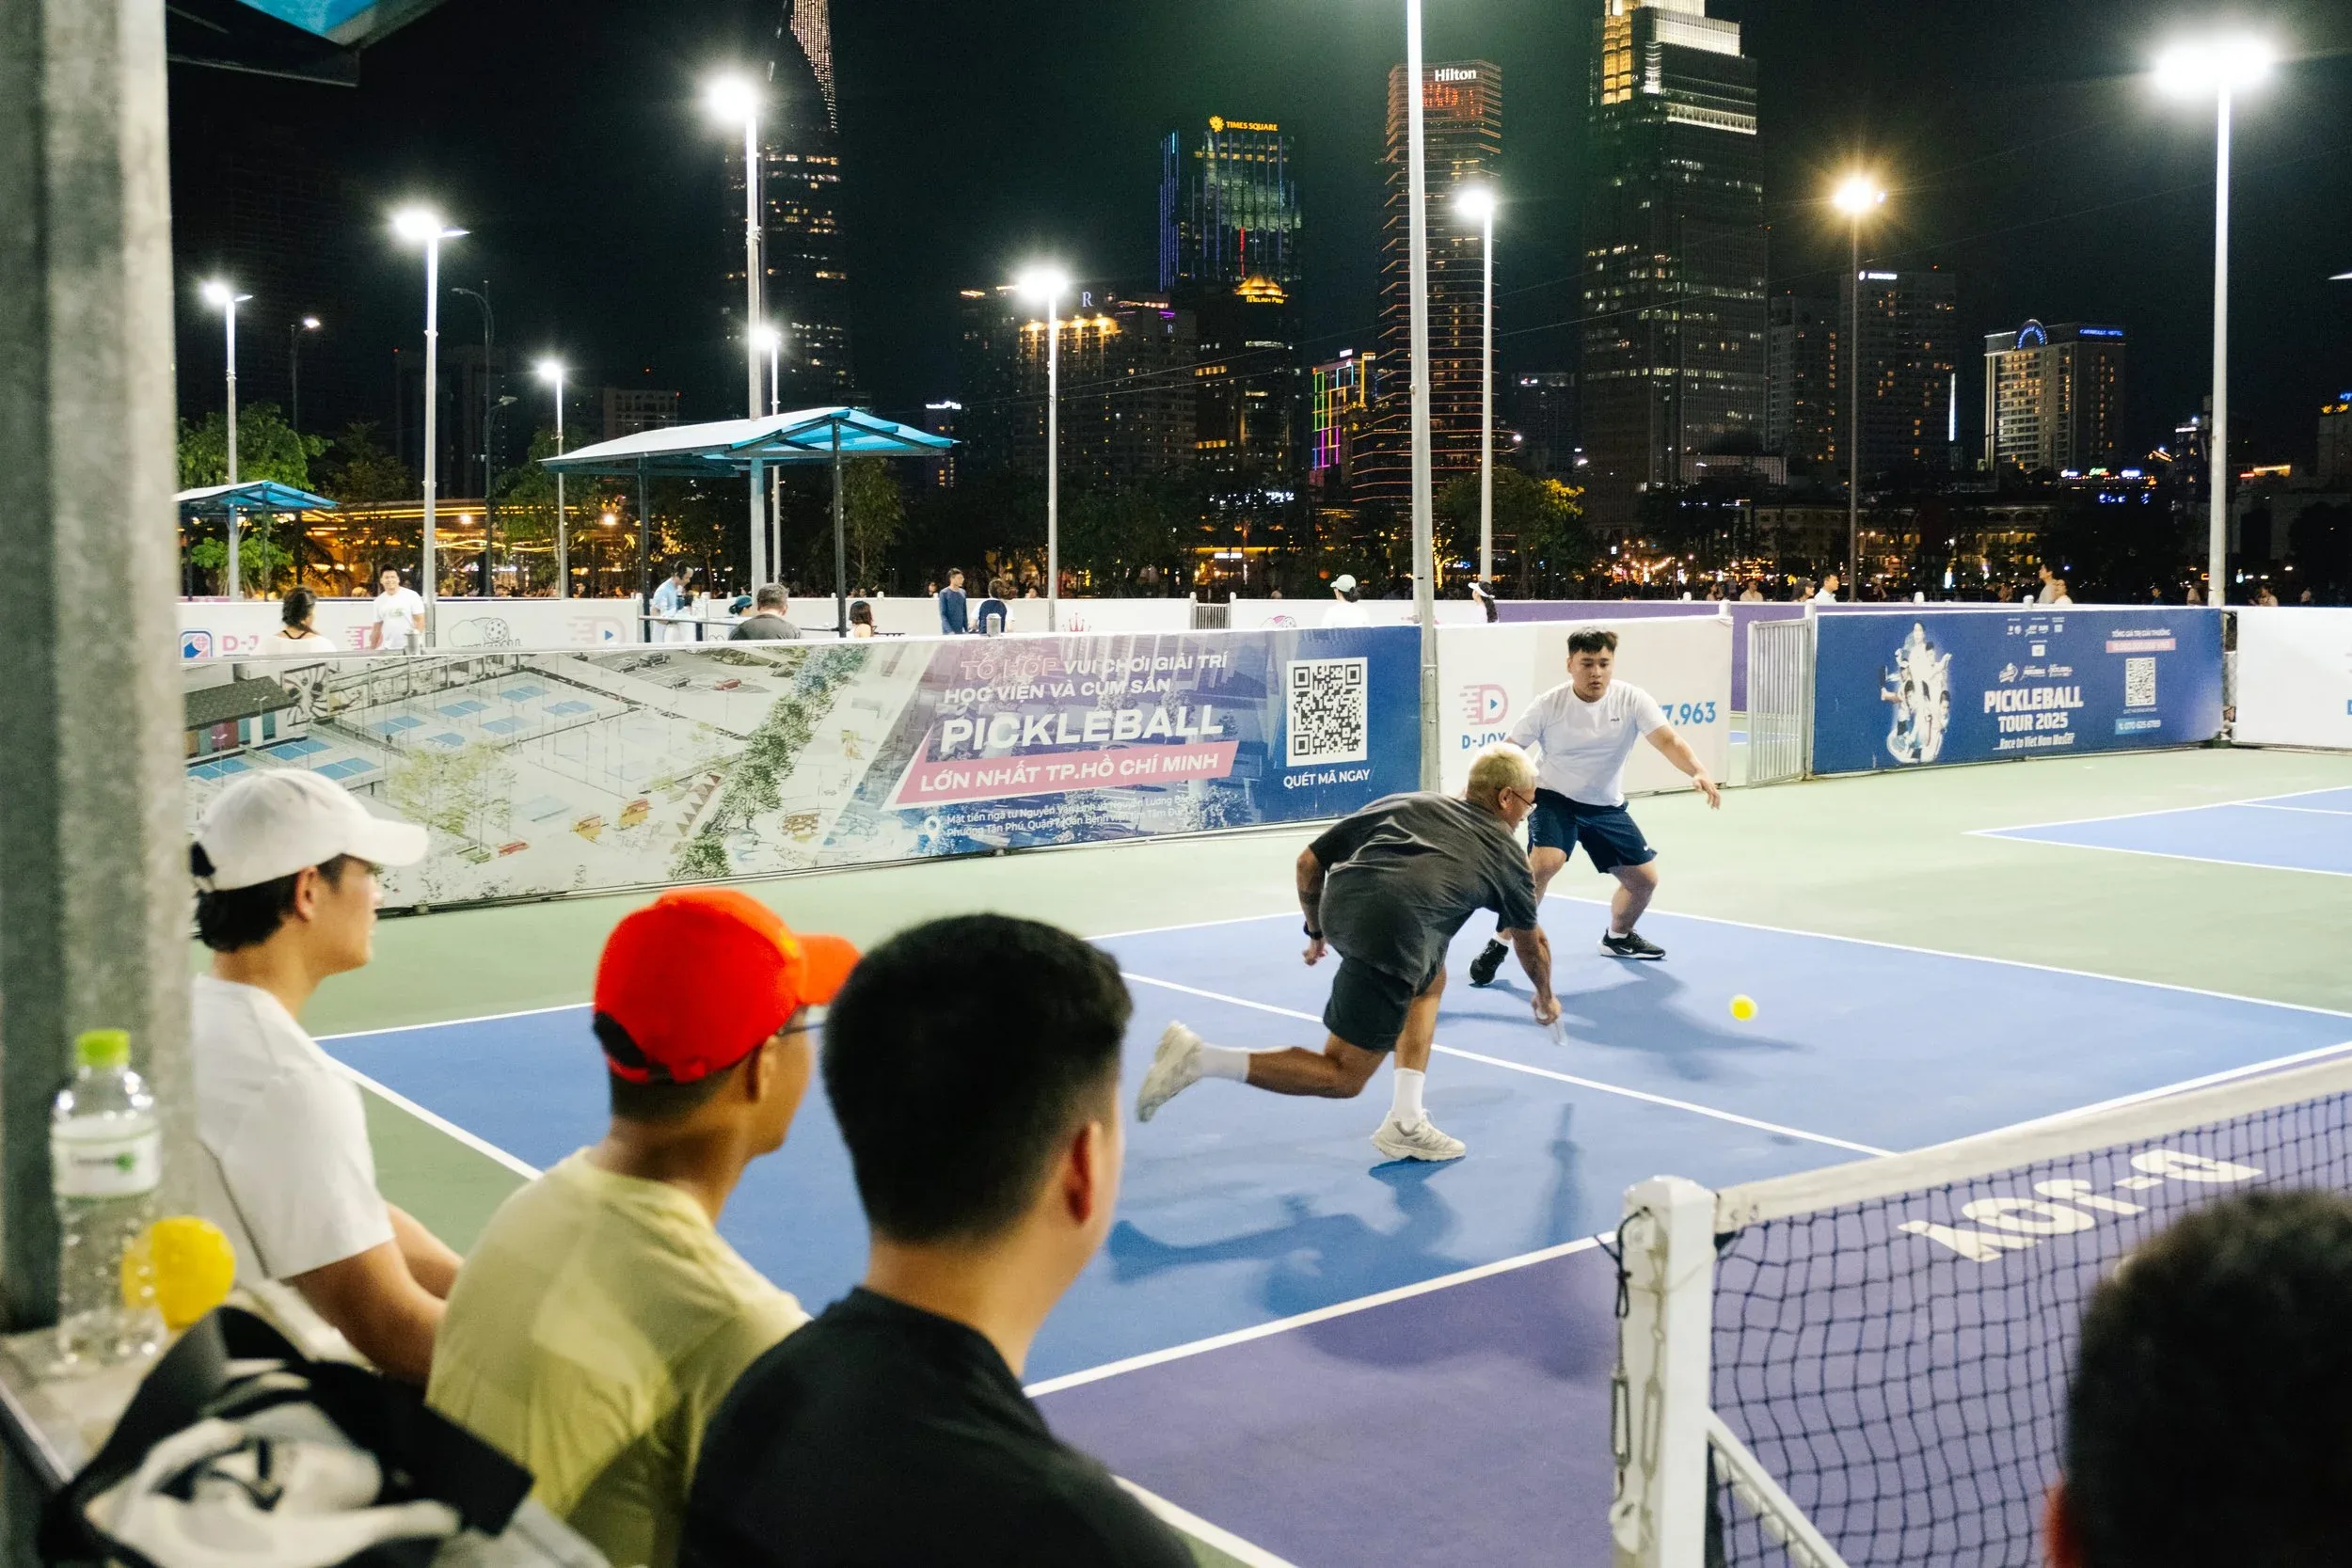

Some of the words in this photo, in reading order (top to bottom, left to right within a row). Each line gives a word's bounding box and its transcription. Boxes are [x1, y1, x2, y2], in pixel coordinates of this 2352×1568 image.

[1435, 68, 1477, 82] Hilton
[1226, 120, 1248, 129] TIMES
[1248, 122, 1278, 131] SQUARE
[1082, 291, 1093, 308] R
[1168, 325, 1173, 333] R
[1064, 659, 1098, 674] VUI
[1154, 653, 1194, 671] GIẢI
[1197, 651, 1229, 669] TRÍ
[996, 683, 1045, 704] VIỆN
[1050, 679, 1075, 698] VÀ
[1984, 686, 2084, 713] PICKLEBALL
[1660, 702, 1716, 725] 7.963
[1998, 714, 2033, 733] TOUR
[2036, 711, 2069, 730] 2025
[941, 705, 1223, 752] PICKLEBALL
[920, 768, 970, 792] LỚN
[976, 760, 1041, 787] NHẤT
[1045, 753, 1115, 783] TP.HỒ
[1120, 753, 1159, 776] CHÍ
[1162, 753, 1219, 773] MINH
[1283, 771, 1316, 789] QUÉT
[1318, 769, 1337, 784] MÃ
[1339, 768, 1371, 783] NGAY
